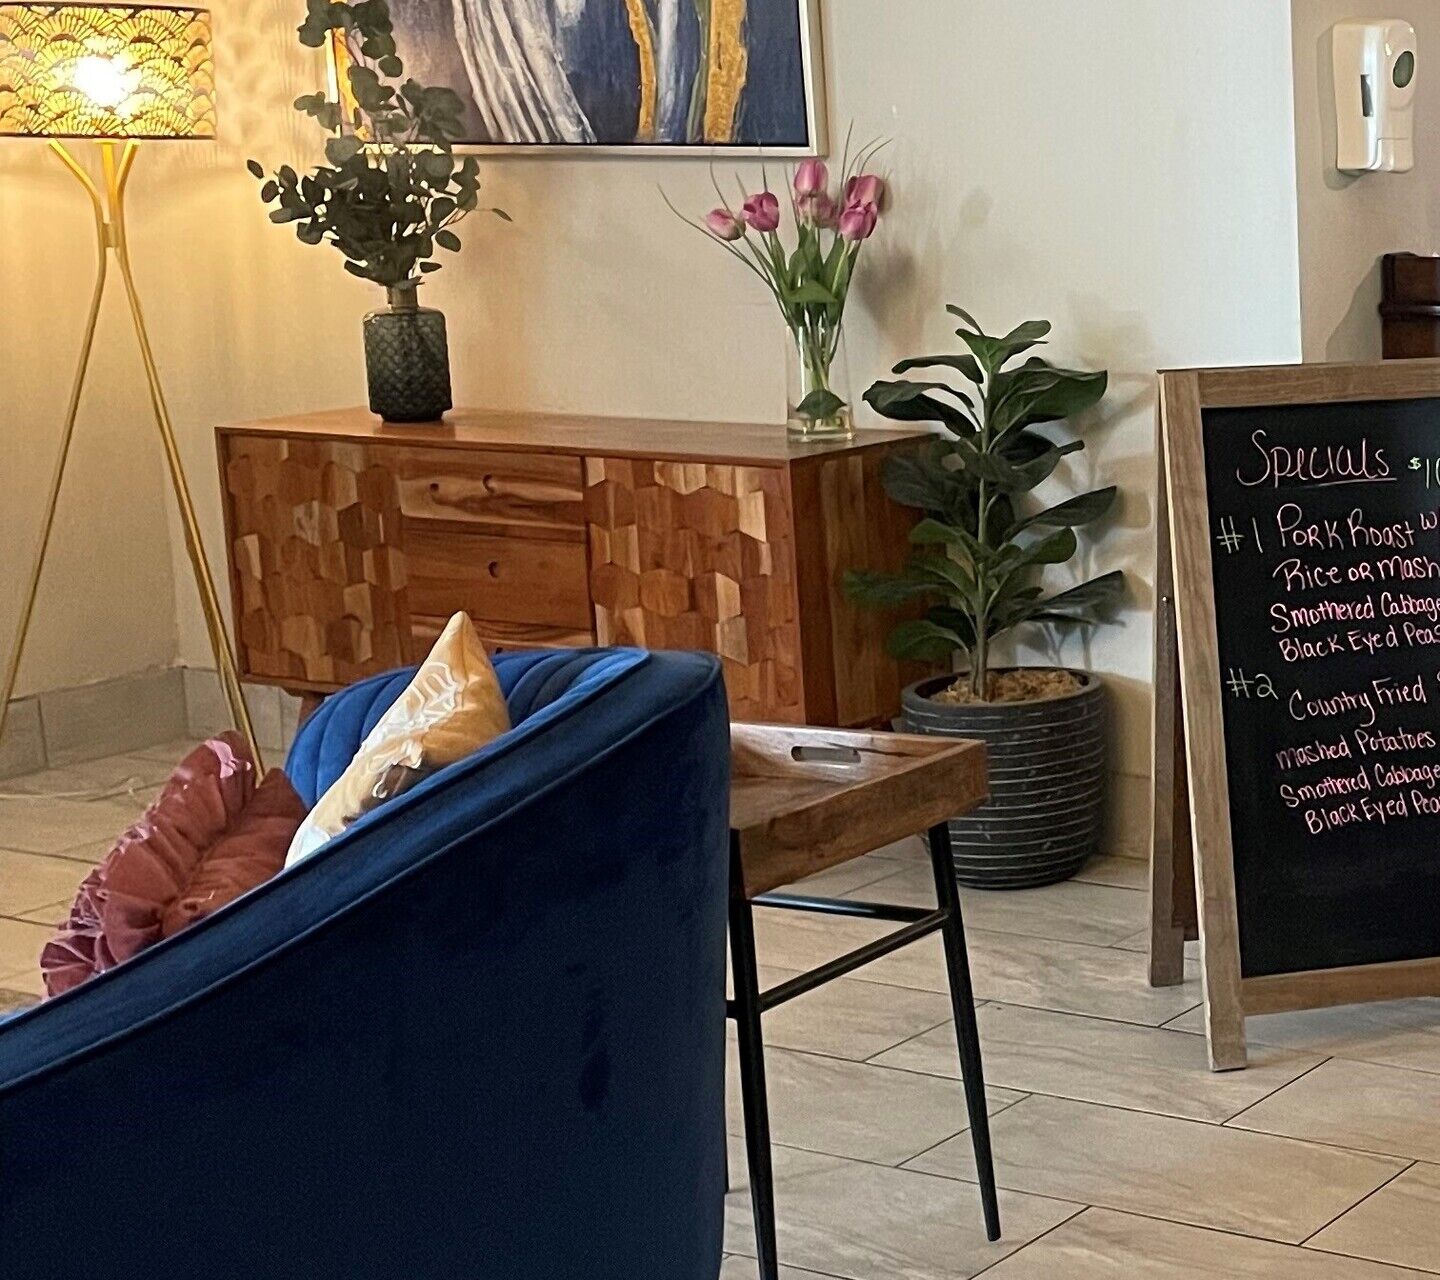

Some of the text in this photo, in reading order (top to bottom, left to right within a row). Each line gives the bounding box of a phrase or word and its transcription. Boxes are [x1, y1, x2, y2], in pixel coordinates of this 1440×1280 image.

[1346, 507, 1415, 550] Roast
[1271, 557, 1343, 592] Rice
[1269, 594, 1375, 634] Smothered
[1346, 623, 1400, 656] Eyed
[1288, 689, 1376, 728] Country
[1371, 674, 1428, 706] Fried
[1353, 728, 1437, 756] Potatoes
[1279, 765, 1372, 809] Smothered
[1358, 795, 1409, 826] Eyed
